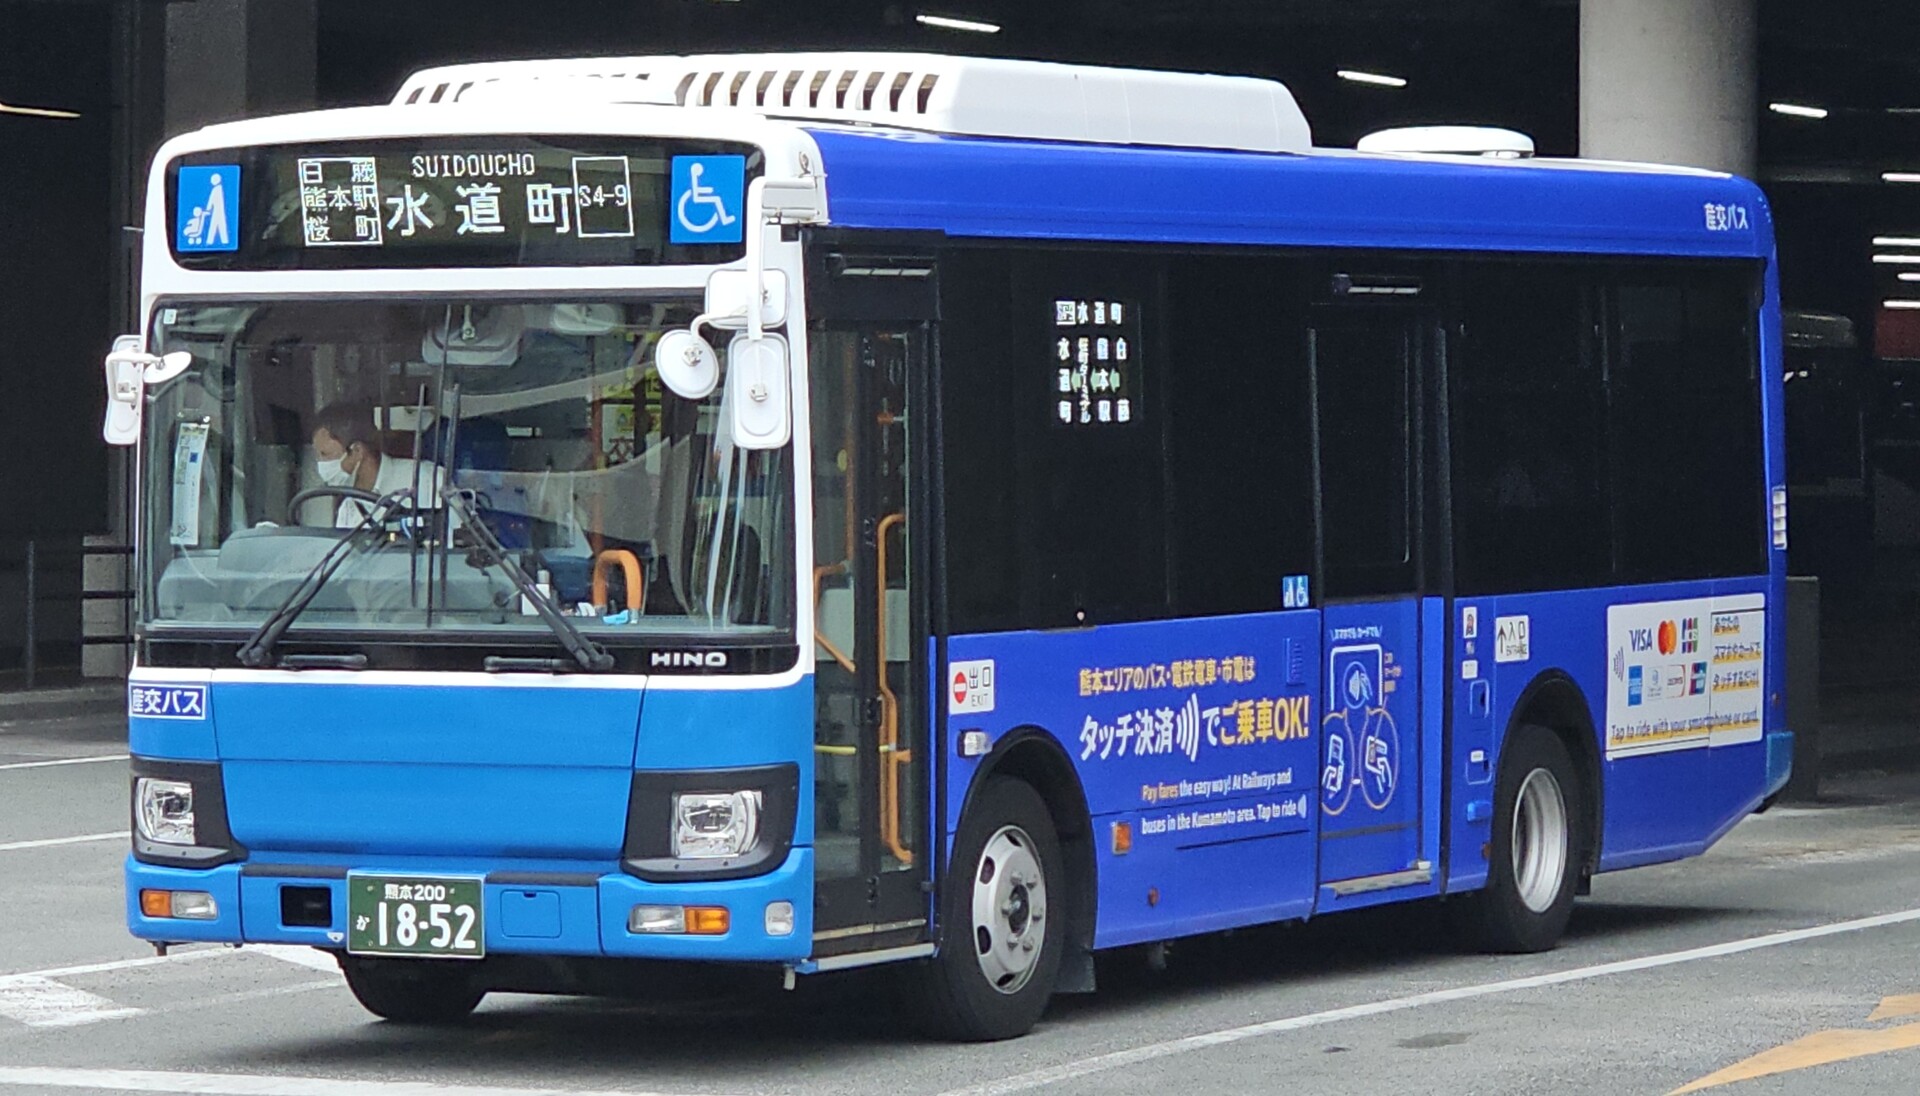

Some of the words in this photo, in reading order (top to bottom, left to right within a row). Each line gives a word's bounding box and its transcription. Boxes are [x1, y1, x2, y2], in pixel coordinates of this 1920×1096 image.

[412, 154, 536, 178] SUIDOUCHO
[303, 184, 378, 212] 熊本駅
[386, 182, 574, 236] 水道町
[579, 184, 628, 207] S4-9
[305, 214, 379, 241] 桜町
[1704, 203, 1749, 231] 産交バス
[1508, 621, 1526, 641] 入口
[1628, 628, 1653, 652] VISA
[651, 652, 727, 667] HINO
[969, 666, 991, 689] 出口
[132, 688, 201, 714] 産交バス
[1079, 706, 1174, 761] タッチ決済
[1202, 694, 1310, 747] でご乗車OK!
[1611, 724, 1625, 744] Tap
[1626, 724, 1635, 738] to
[1635, 720, 1650, 737] ride
[1652, 718, 1668, 735] with
[1741, 704, 1758, 724] card
[1142, 785, 1157, 804] Pay
[1179, 779, 1192, 797] the
[1242, 771, 1276, 790] Railways
[1277, 767, 1292, 786] and
[1141, 817, 1166, 835] buses
[1167, 814, 1176, 831] in
[1177, 813, 1190, 830] the
[1257, 803, 1271, 822] Tap
[1272, 803, 1281, 818] to
[1282, 799, 1297, 816] ride
[384, 883, 446, 901] 熊本200
[378, 901, 476, 949] 18-52
